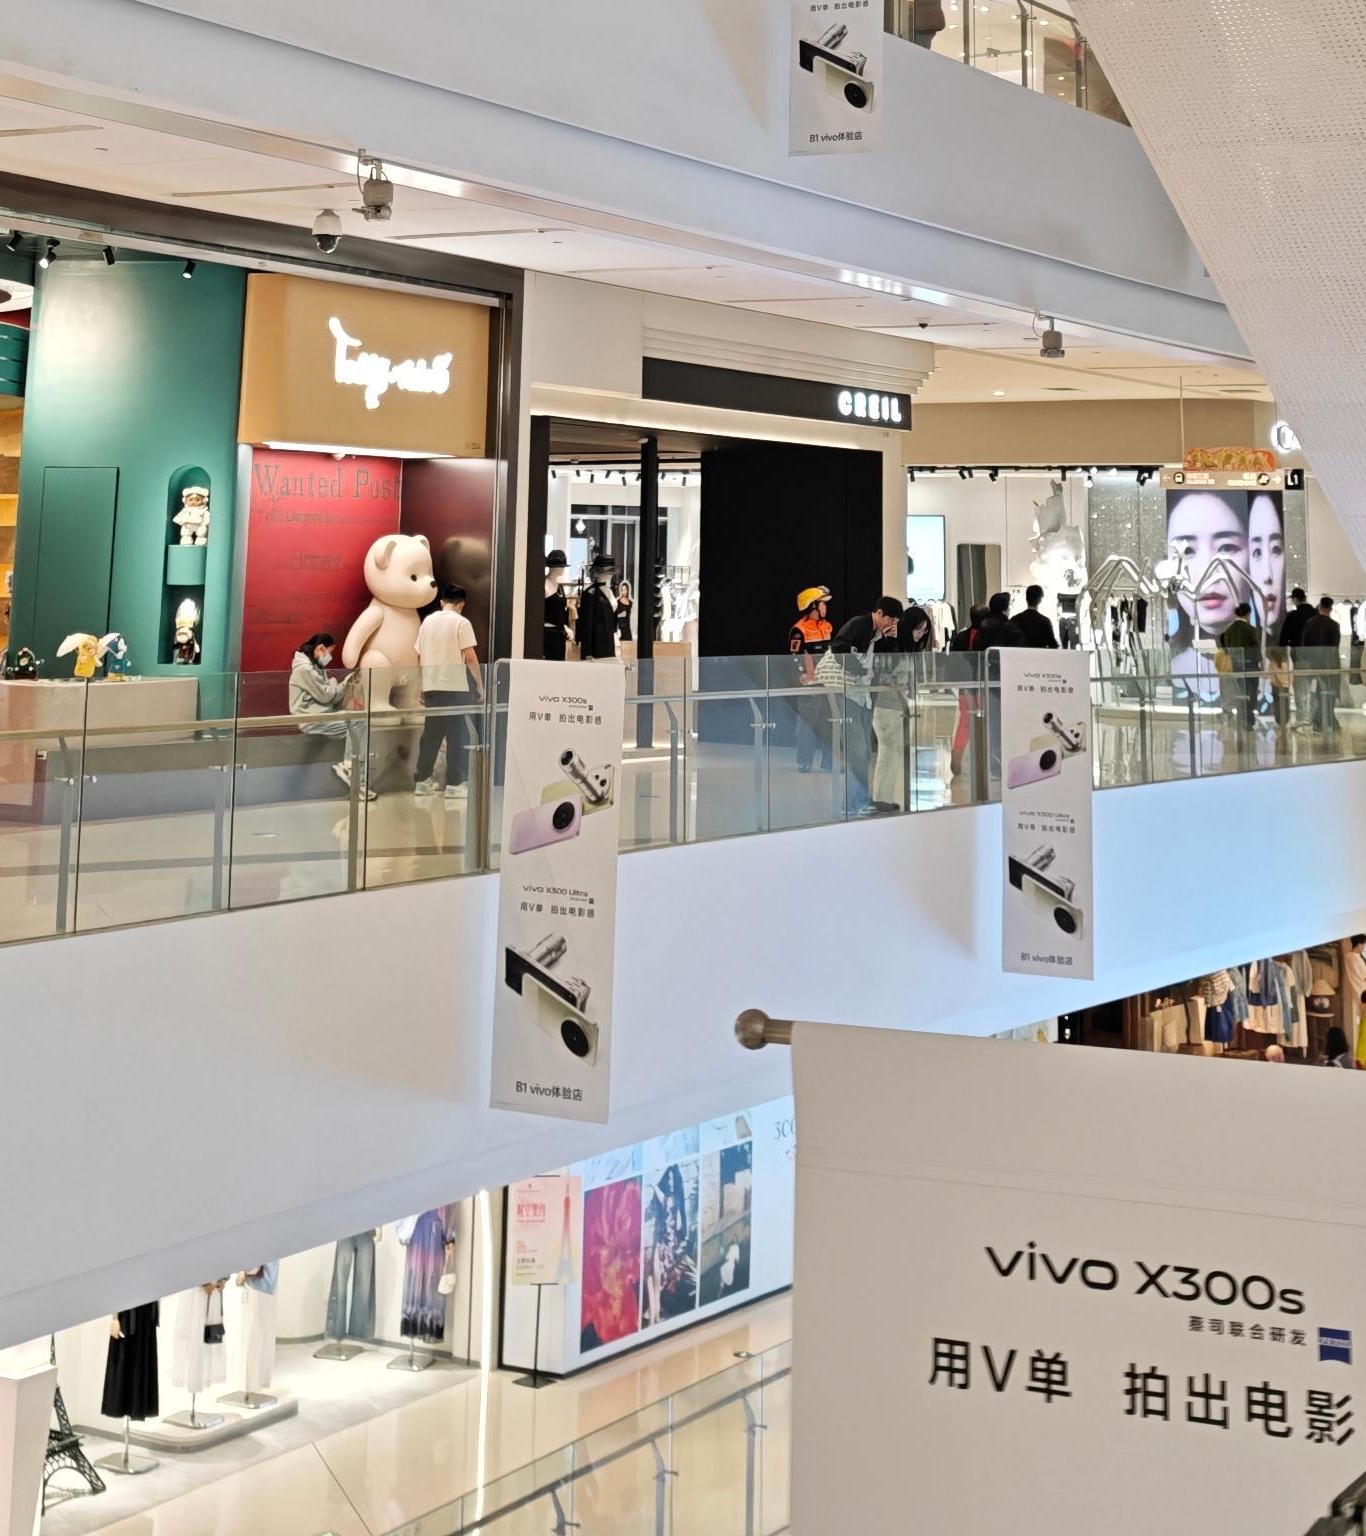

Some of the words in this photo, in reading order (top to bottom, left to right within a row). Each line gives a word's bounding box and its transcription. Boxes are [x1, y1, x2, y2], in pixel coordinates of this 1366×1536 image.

[809, 133, 819, 142] B1
[821, 129, 863, 142] vivo体验店
[254, 463, 343, 498] Wanted
[515, 1081, 527, 1093] B1
[530, 1083, 583, 1102] vivo体验店
[984, 1240, 1119, 1291] vivo
[1134, 1261, 1307, 1315] X300s
[929, 1336, 1073, 1404] 用V单
